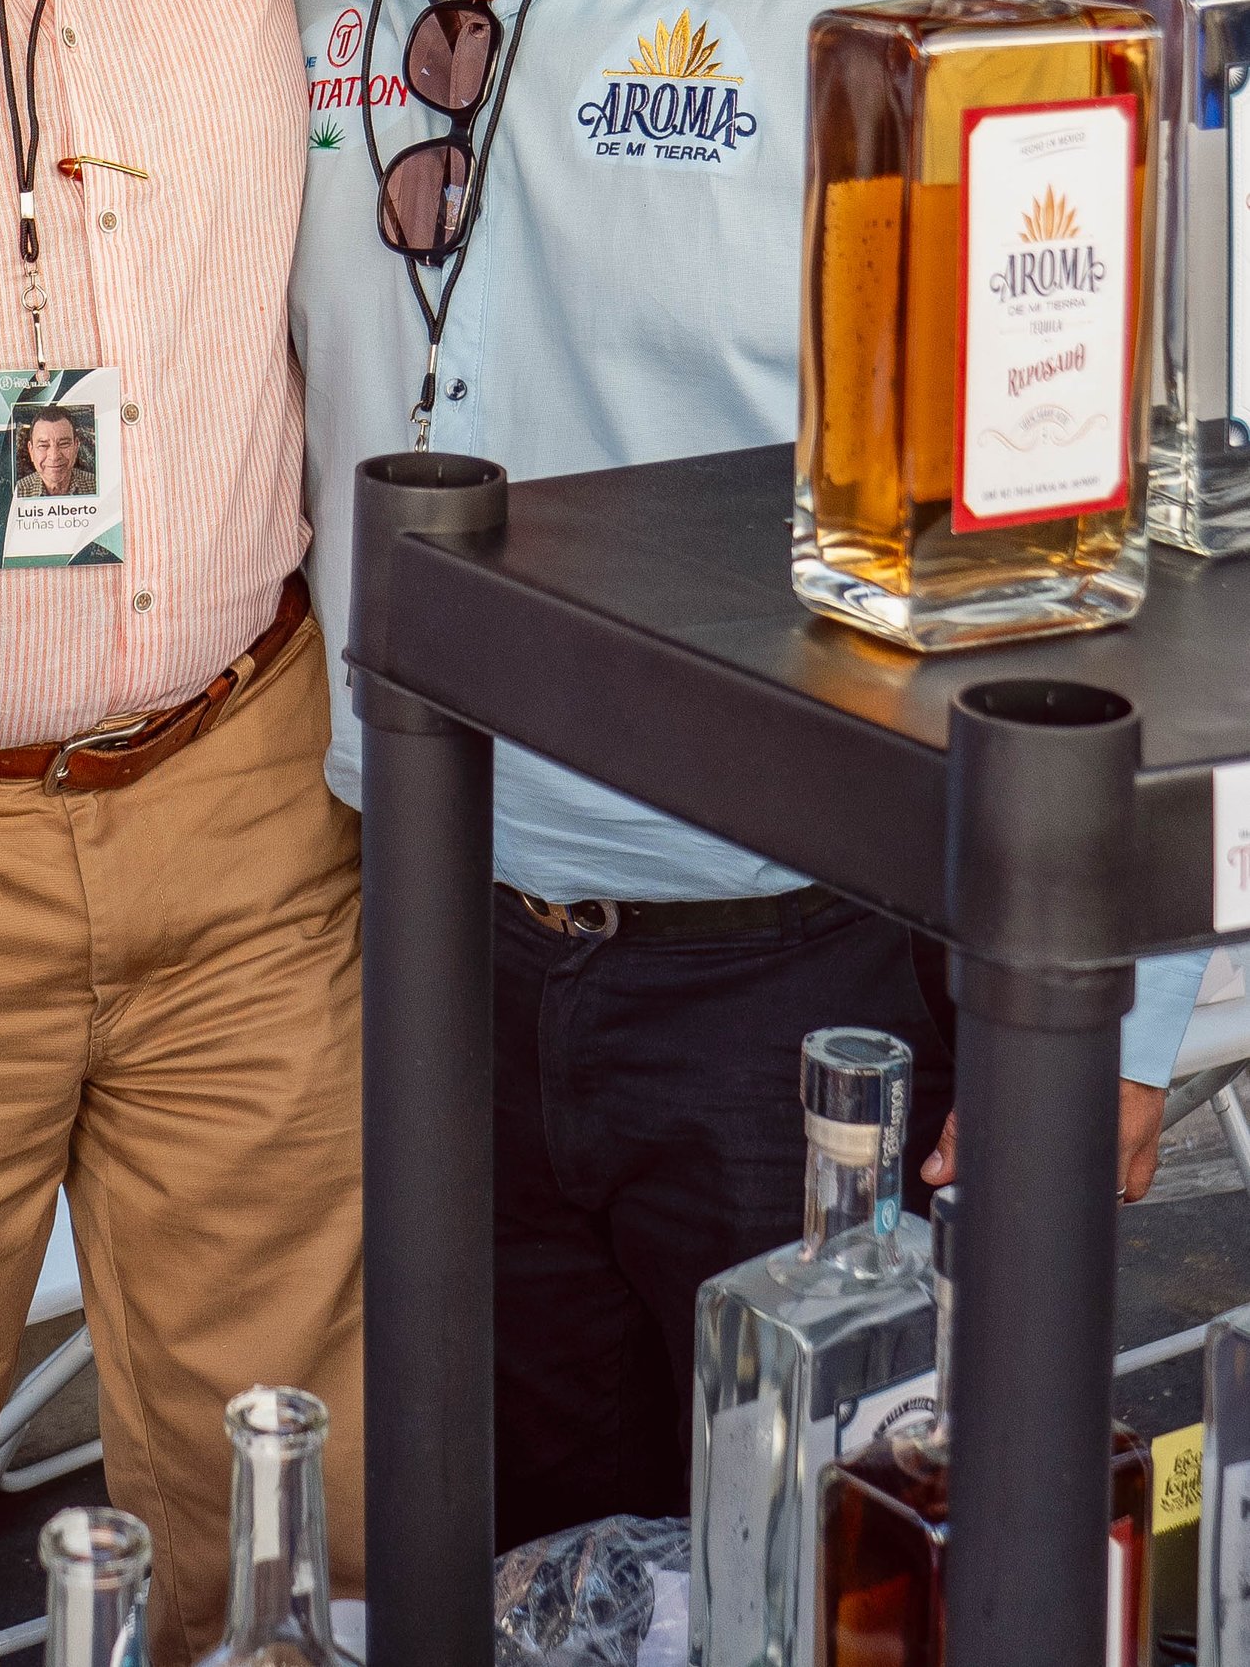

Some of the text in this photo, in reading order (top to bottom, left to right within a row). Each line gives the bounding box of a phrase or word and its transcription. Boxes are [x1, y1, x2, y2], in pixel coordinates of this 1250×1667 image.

[578, 82, 757, 150] AROMA
[596, 142, 721, 163] DE MI TIERRA
[990, 245, 1105, 302] AROMA
[1007, 304, 1024, 316] DE
[1046, 297, 1086, 311] TIERRA
[1029, 318, 1063, 334] TEQUILA
[1007, 343, 1087, 398] REPOSADO
[17, 504, 97, 518] Luis Alberto
[16, 517, 90, 530] Tuñas Lobo
